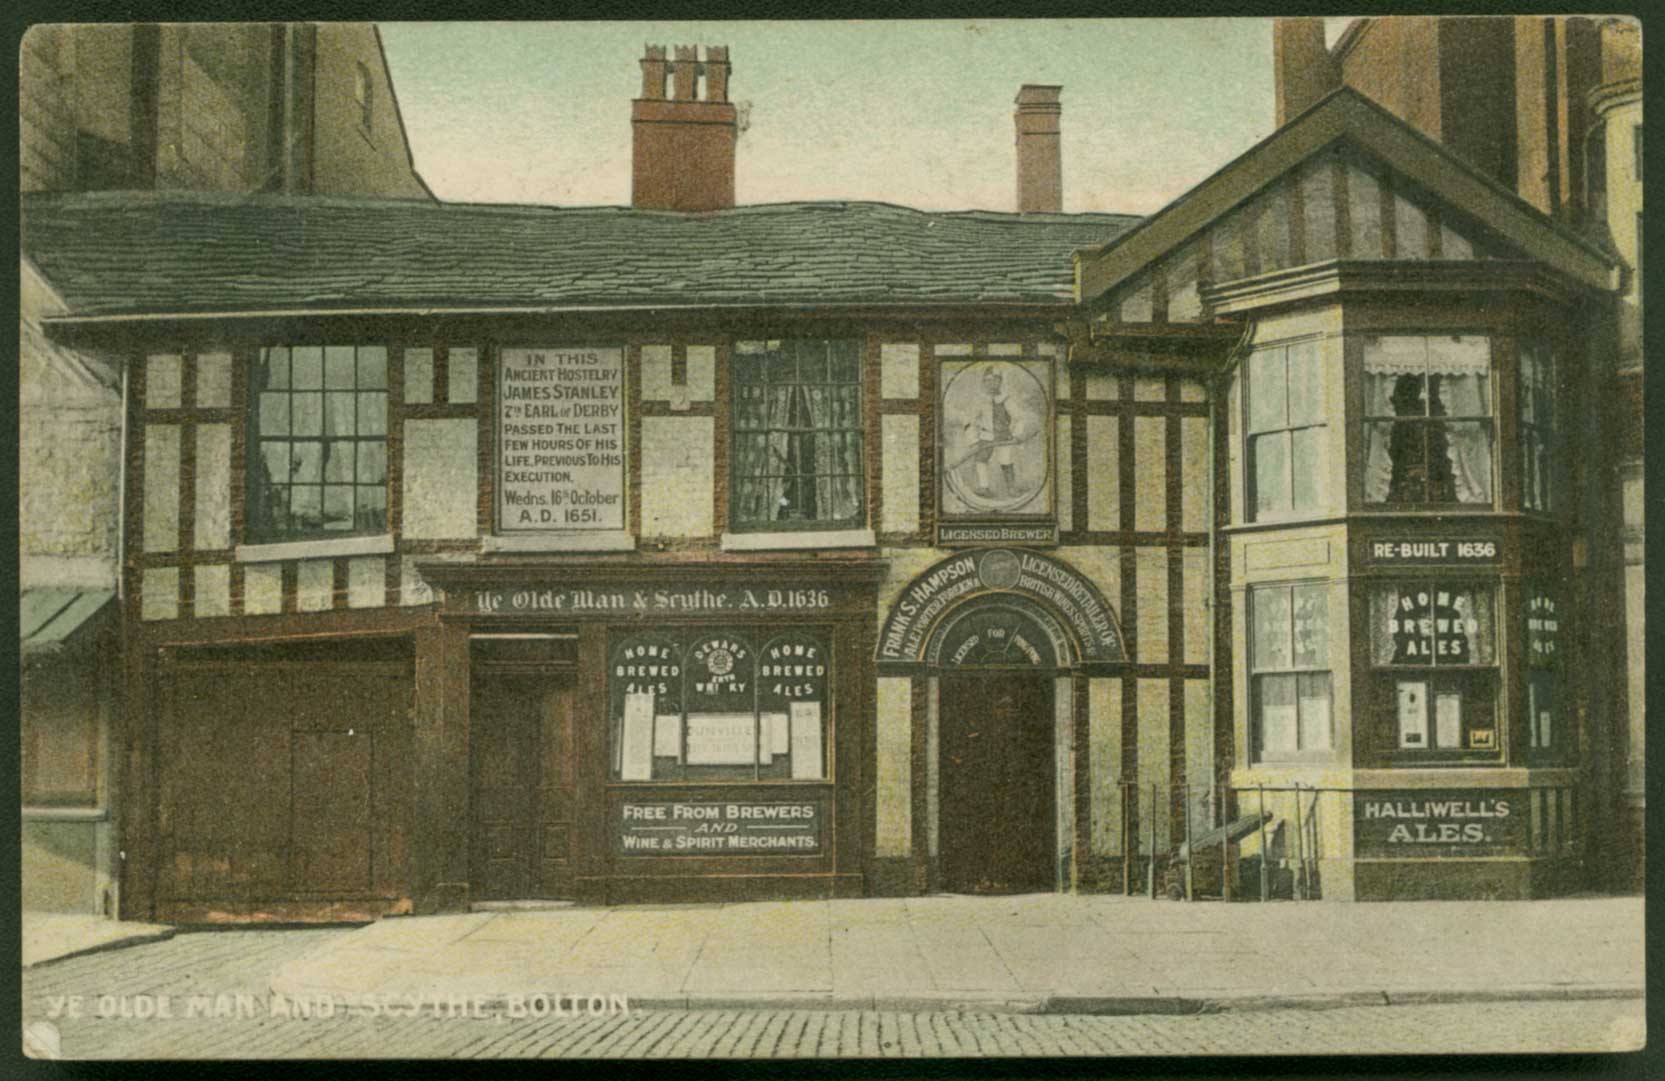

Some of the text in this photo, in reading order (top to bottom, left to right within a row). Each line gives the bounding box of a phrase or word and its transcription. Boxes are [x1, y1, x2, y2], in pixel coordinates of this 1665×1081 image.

[527, 353, 599, 366] IN THIS
[504, 367, 619, 382] ANCIENT HOSTELRY
[503, 384, 618, 400] JAMES STANLEY
[524, 403, 558, 418] EARL
[573, 403, 619, 418] DERBY
[504, 423, 617, 435] PASSED THE LAST
[504, 438, 618, 450] FEW HOURS OF HIS
[534, 454, 586, 466] PREVIOUS
[601, 453, 621, 466] HIS
[570, 489, 620, 505] October
[519, 509, 557, 523] A.D.
[941, 528, 1000, 540] LICENSED
[1374, 542, 1497, 558] RE-BUILT 1636
[512, 591, 566, 609] Olde
[570, 590, 626, 611] Man
[633, 590, 648, 609] &
[1021, 553, 1077, 591] LICENSED
[1073, 580, 1110, 633] RETAILER
[882, 556, 976, 657] FRANK S. HAMPSON
[1401, 592, 1465, 612] HOME
[1387, 619, 1478, 635] BREWED
[625, 645, 671, 660] HOME
[694, 639, 747, 660] DEWARS
[771, 646, 816, 660] HOME
[1406, 640, 1462, 655] ALES
[616, 665, 680, 677] BREWED
[762, 666, 825, 677] BREWED
[773, 684, 814, 697] ALES
[623, 805, 814, 820] FREE FROM BREWERS
[1365, 799, 1510, 819] HALLIWELL'S
[694, 823, 738, 833] AND
[1387, 823, 1492, 843] ALES.
[623, 835, 819, 849] WINE & SPIRIT MERCHANTS.
